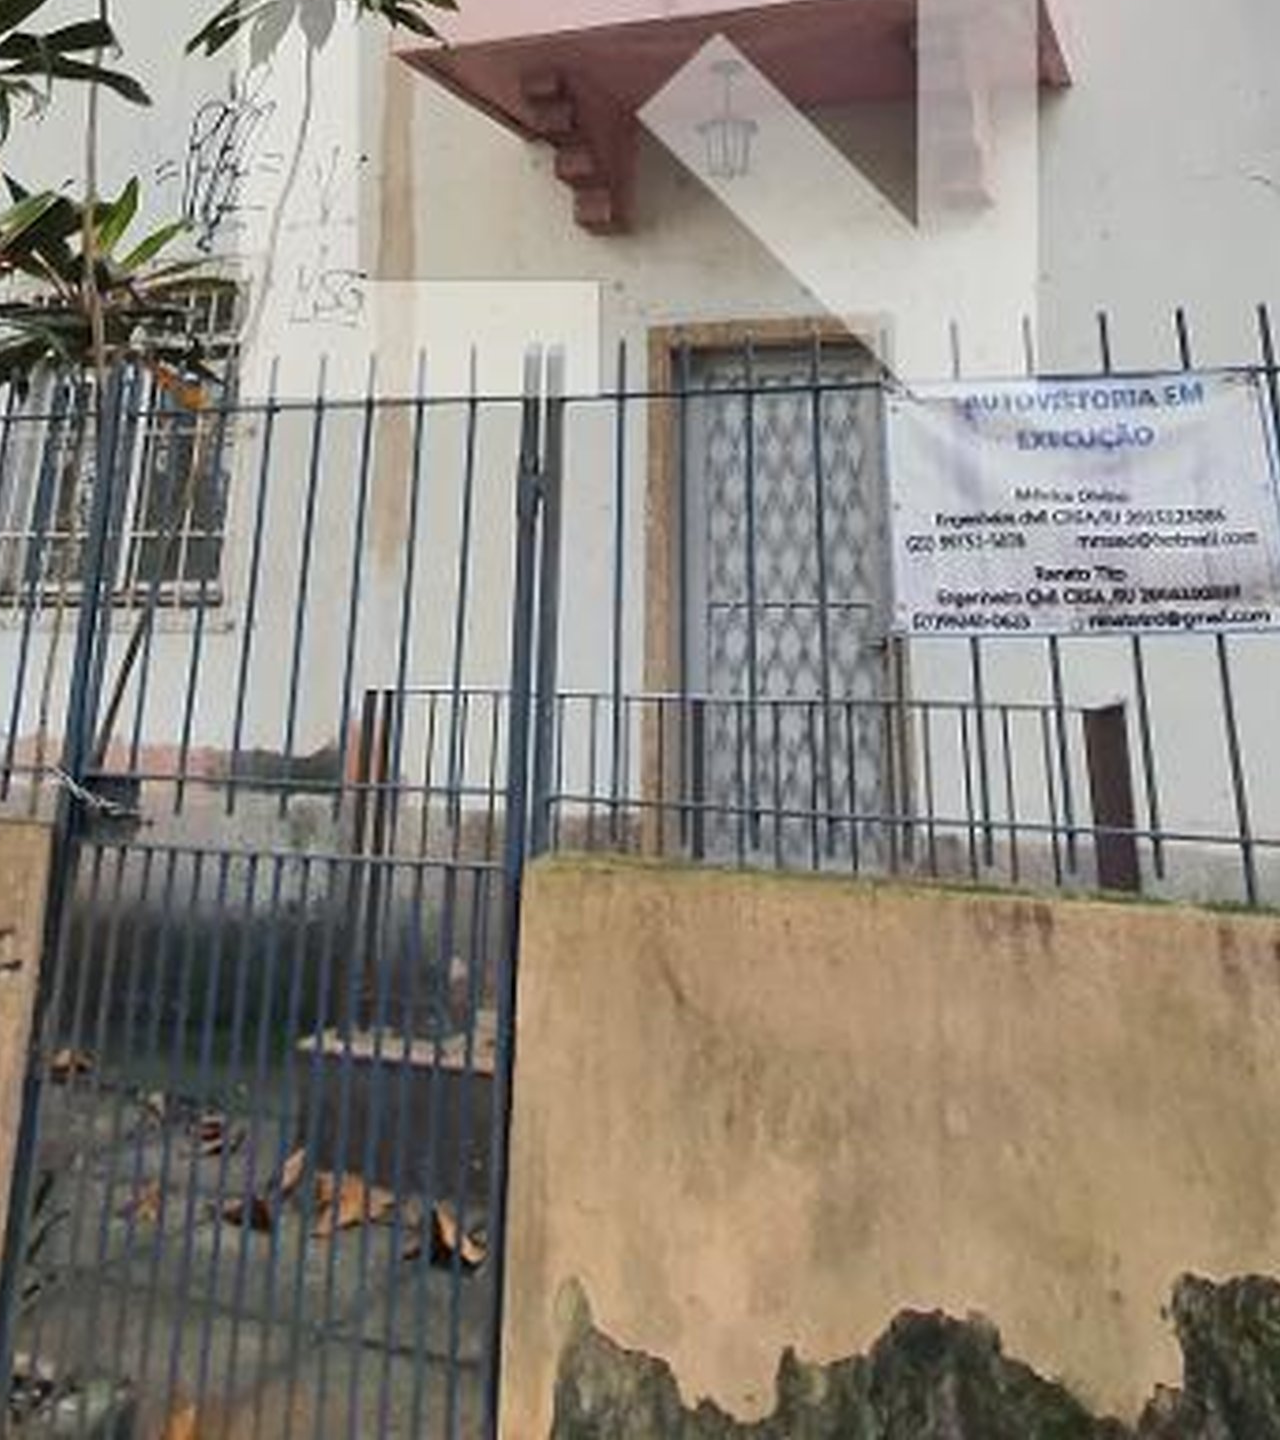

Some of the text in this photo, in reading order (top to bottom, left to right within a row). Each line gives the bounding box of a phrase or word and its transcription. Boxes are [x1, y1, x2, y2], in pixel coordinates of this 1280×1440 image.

[967, 382, 1204, 415] AUTOVISTORIA EM
[1018, 424, 1154, 452] EXECUÇÃO
